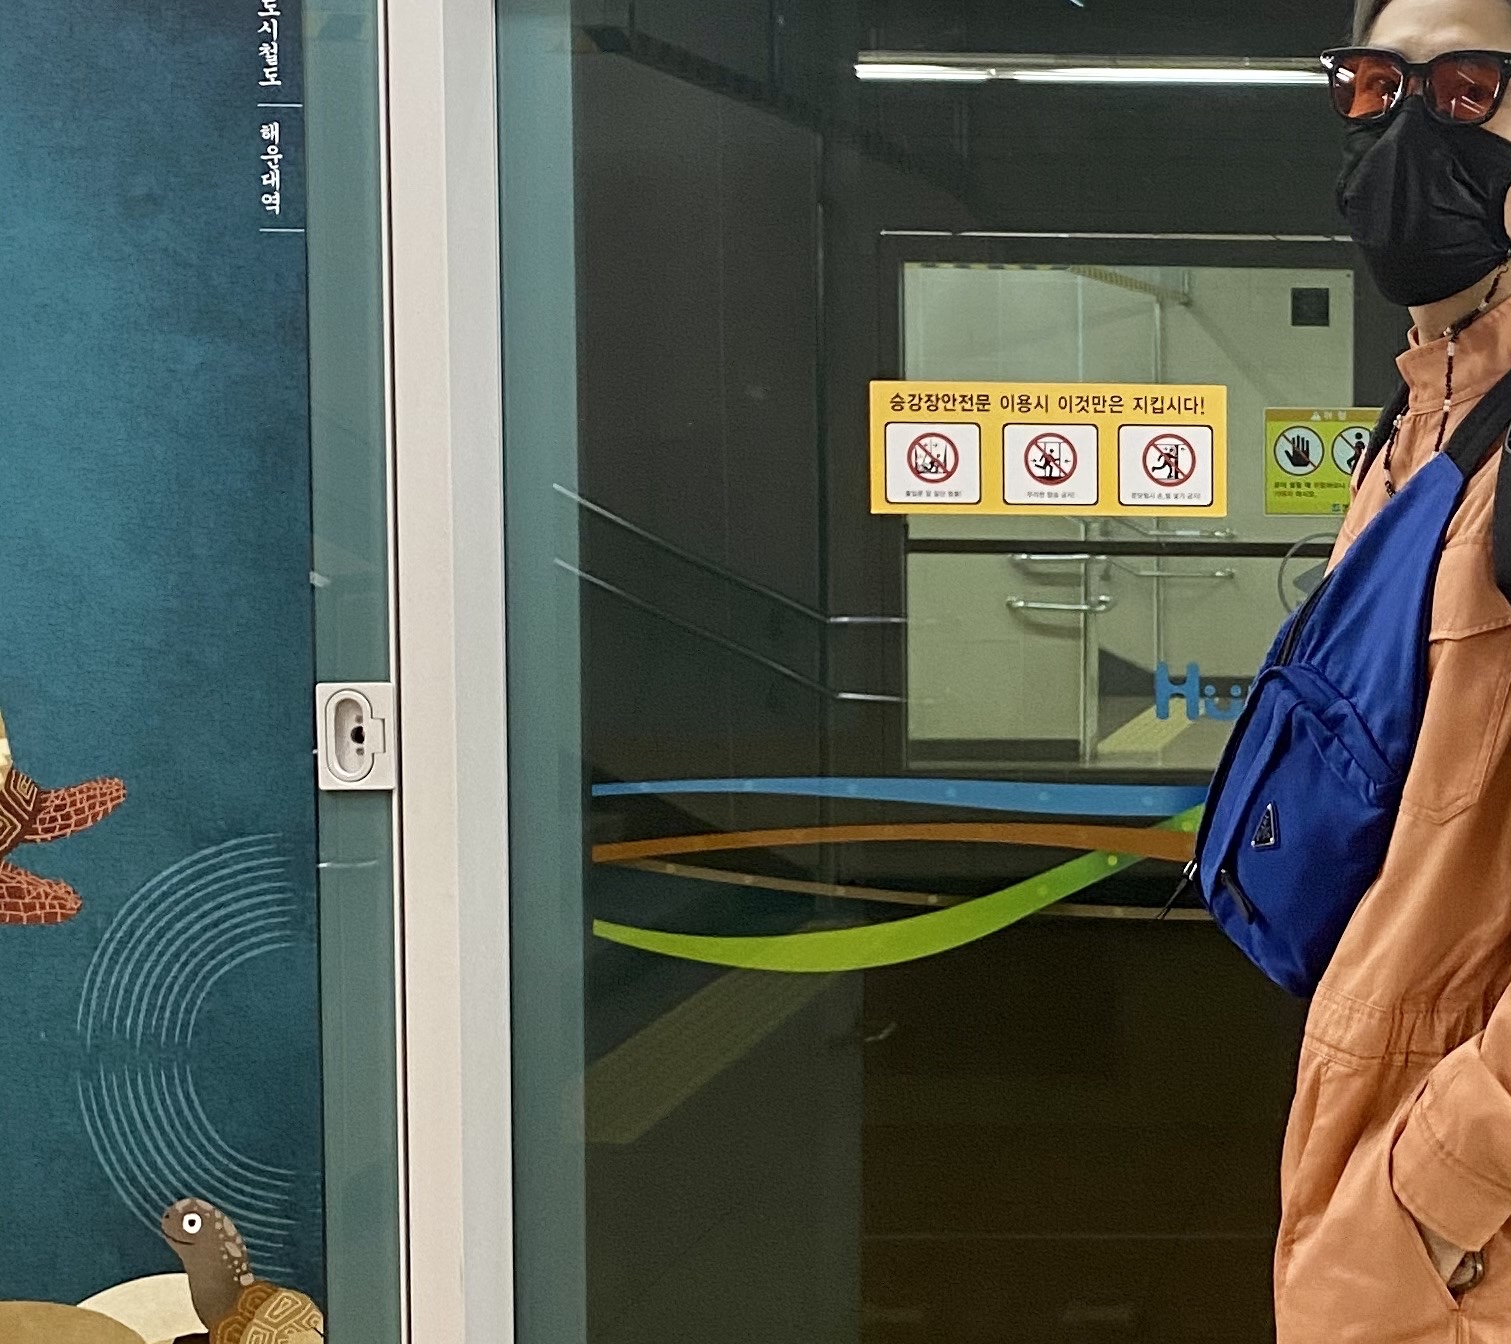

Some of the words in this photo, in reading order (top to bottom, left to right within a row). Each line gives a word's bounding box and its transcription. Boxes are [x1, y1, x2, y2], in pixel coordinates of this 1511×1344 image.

[260, 121, 283, 215] 해운대역
[889, 392, 992, 413] 승강장안전문
[1000, 395, 1049, 413] 이용시
[1058, 395, 1124, 414] 이것만은
[1133, 396, 1205, 415] 지킵시다!
